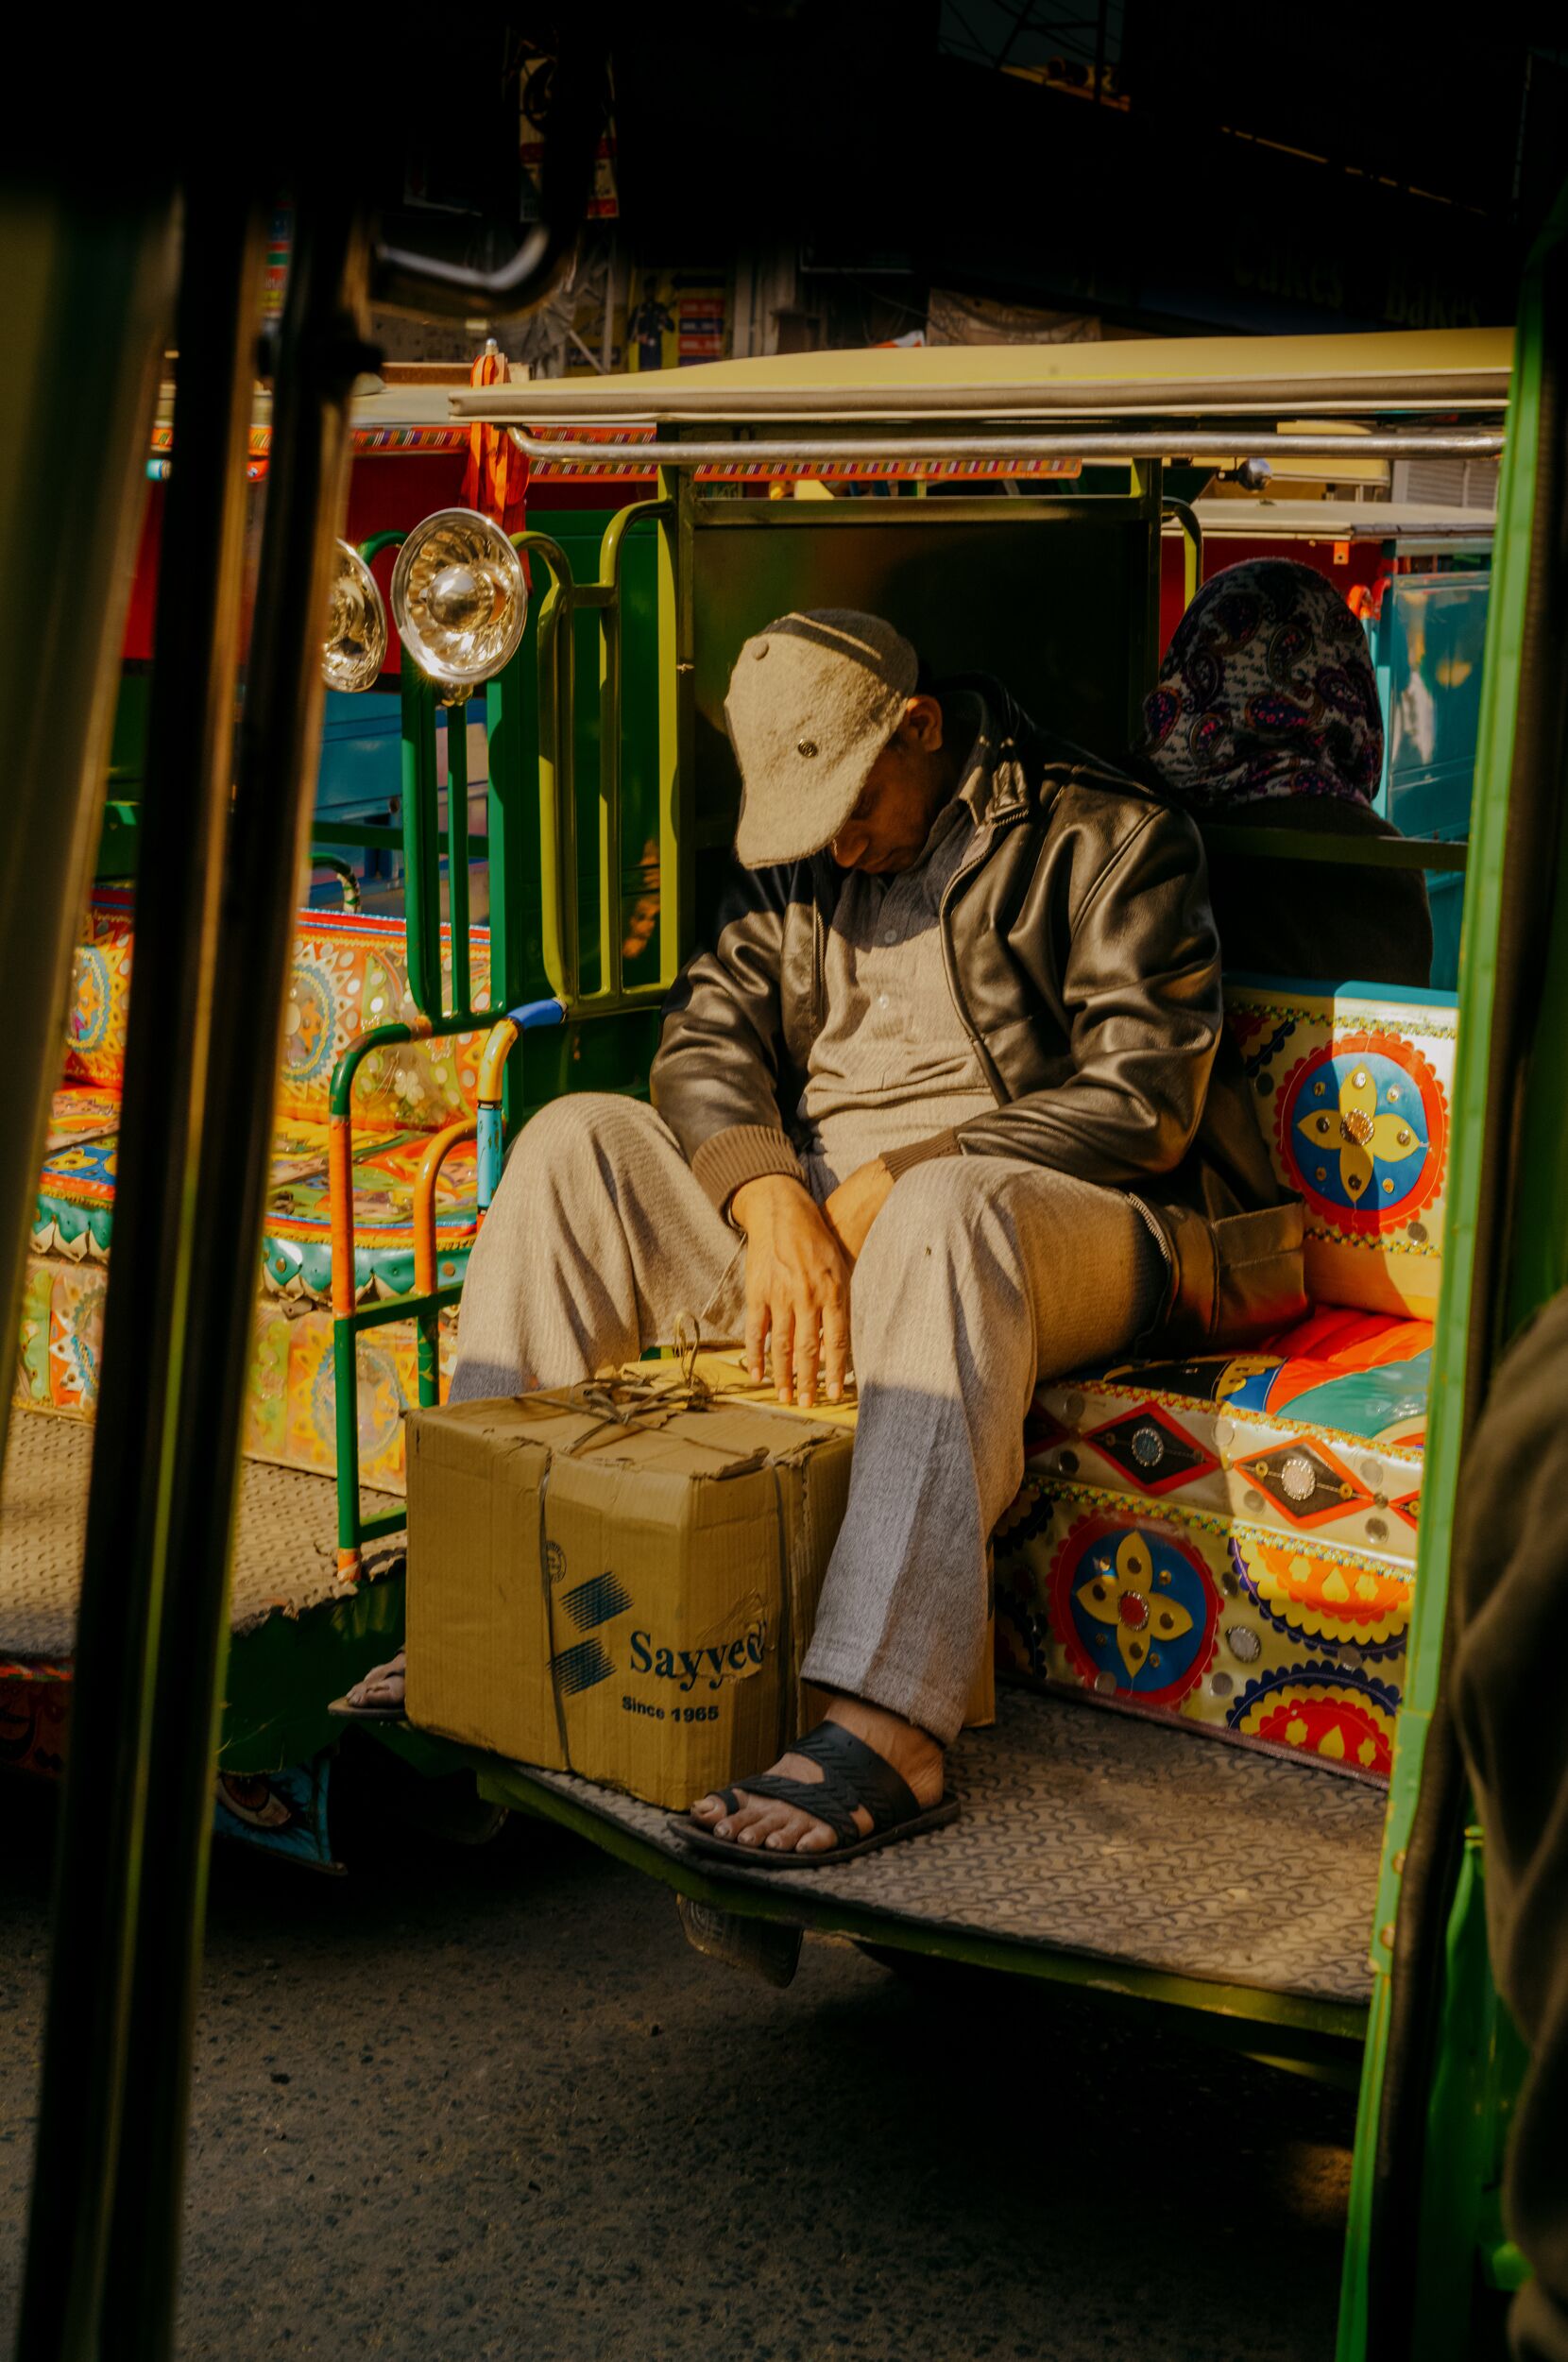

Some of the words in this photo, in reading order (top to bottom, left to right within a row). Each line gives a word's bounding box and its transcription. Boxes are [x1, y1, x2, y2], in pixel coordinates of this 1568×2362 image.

[630, 1619, 766, 1691] Sayyed
[622, 1696, 665, 1720] Since
[671, 1705, 719, 1722] 1965
